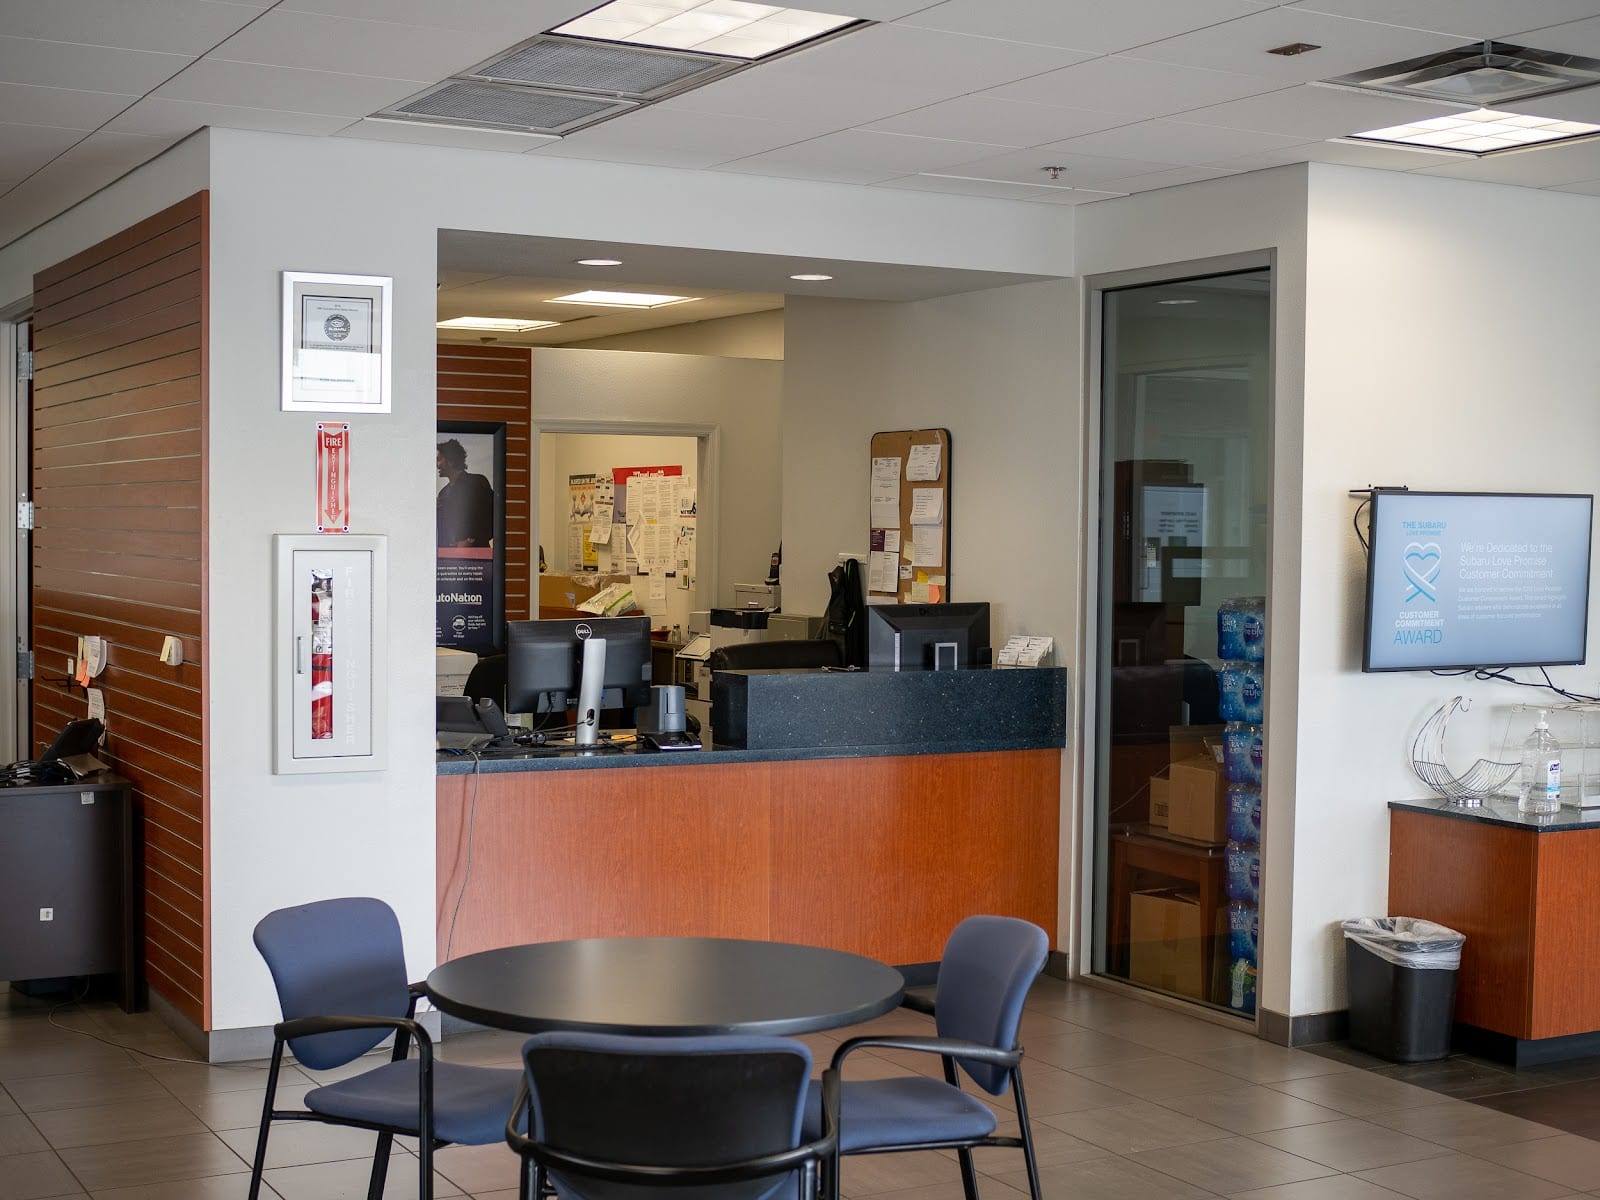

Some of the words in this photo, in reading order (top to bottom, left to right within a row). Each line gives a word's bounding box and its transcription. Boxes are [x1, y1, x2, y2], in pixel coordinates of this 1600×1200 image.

[325, 437, 342, 447] FIRE
[1418, 521, 1447, 529] SUBARU
[1460, 542, 1485, 553] We're
[1486, 543, 1529, 553] Dedicated
[1529, 543, 1539, 553] to
[1540, 543, 1553, 553] the
[1459, 555, 1490, 566] Subaru
[1492, 556, 1512, 566] Love
[1514, 556, 1548, 567] Promise
[1459, 568, 1500, 579] Customer
[1502, 568, 1553, 579] Commitment
[344, 566, 354, 608] FIRE
[436, 592, 483, 603] utoNation
[1399, 610, 1439, 619] CUSTOMER
[1395, 619, 1445, 628] COMMITMENT
[1393, 629, 1443, 645] AWARD
